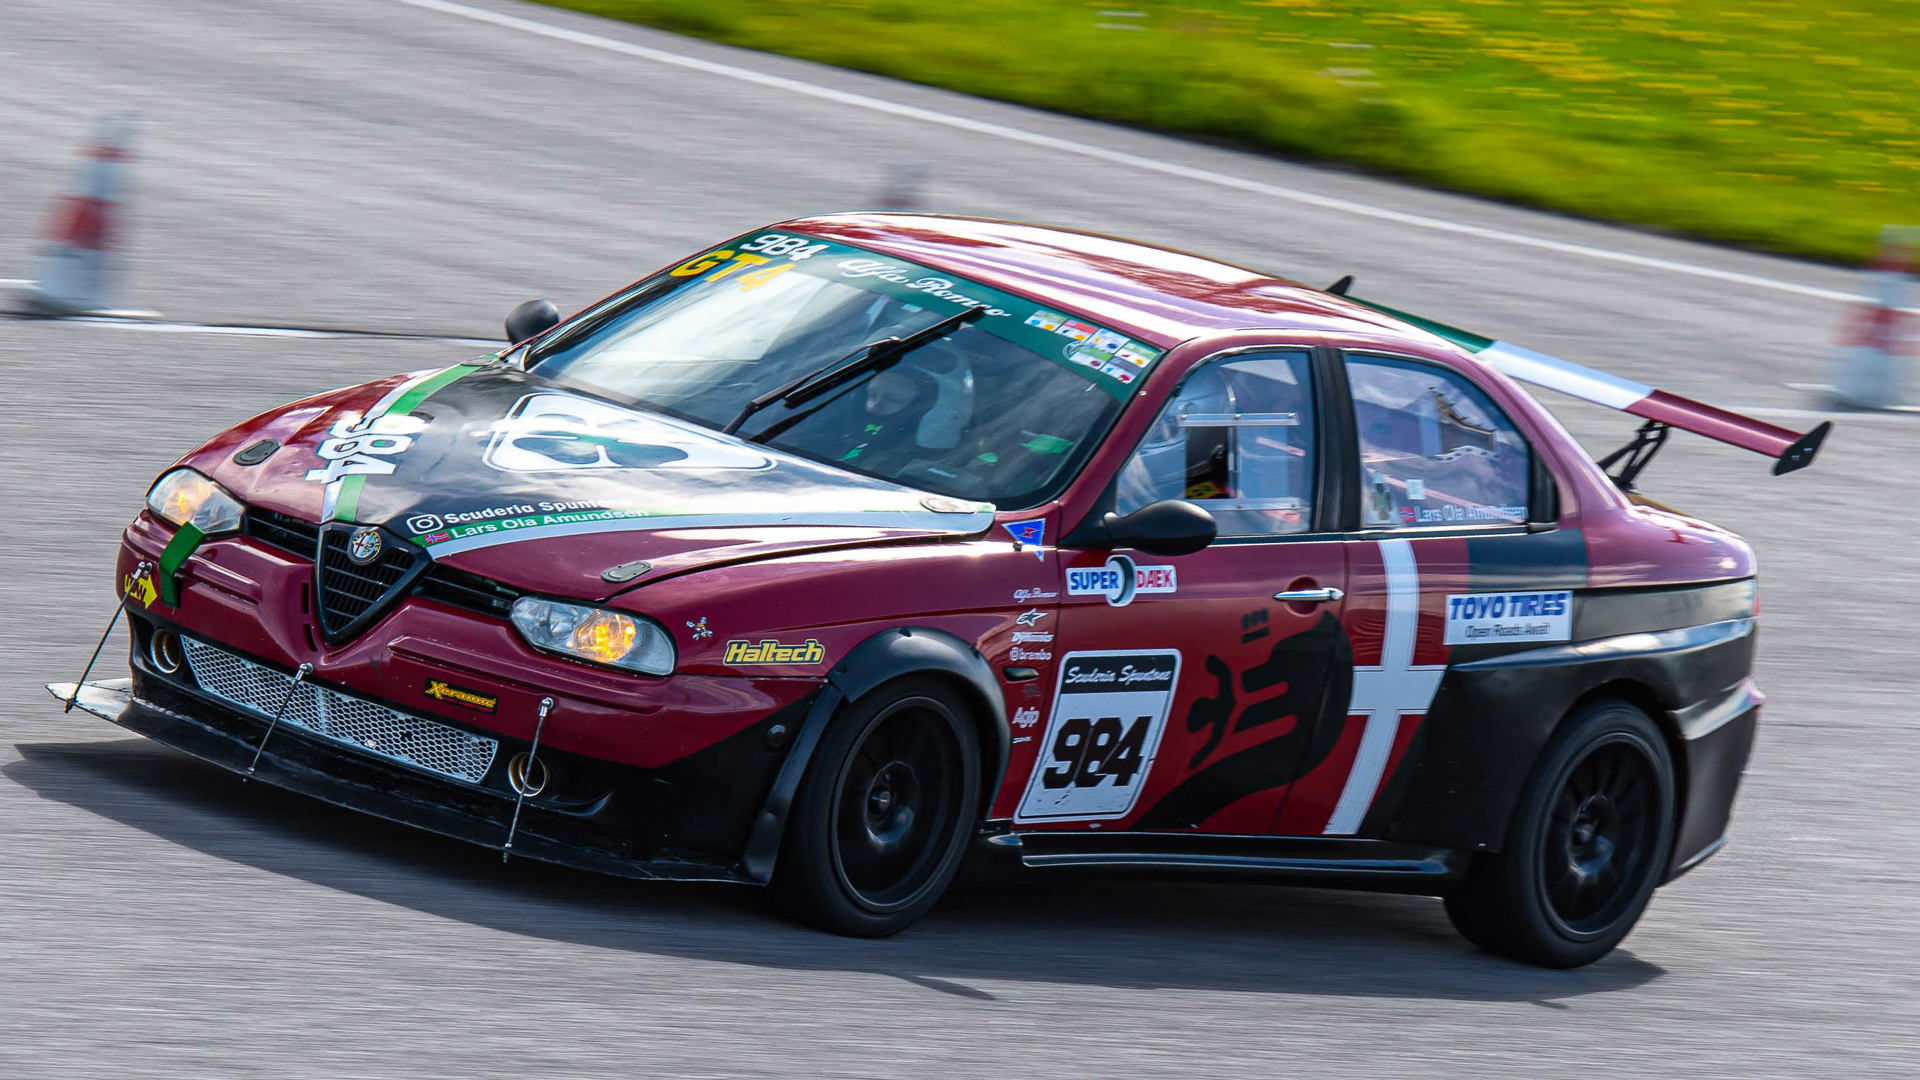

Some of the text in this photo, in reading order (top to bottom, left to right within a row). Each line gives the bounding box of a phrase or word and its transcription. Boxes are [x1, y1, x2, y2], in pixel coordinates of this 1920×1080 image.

[739, 233, 831, 262] 984
[670, 249, 796, 292] GT4
[836, 258, 910, 284] Alfa
[304, 411, 431, 485] 984
[443, 498, 632, 525] Scuderia Spunto
[451, 509, 649, 539] Lars Ola Amundsen
[1070, 570, 1120, 591] SUPER
[1450, 593, 1568, 620] TOYO TIRES
[726, 642, 823, 662] Haltech
[1042, 715, 1153, 790] 984
